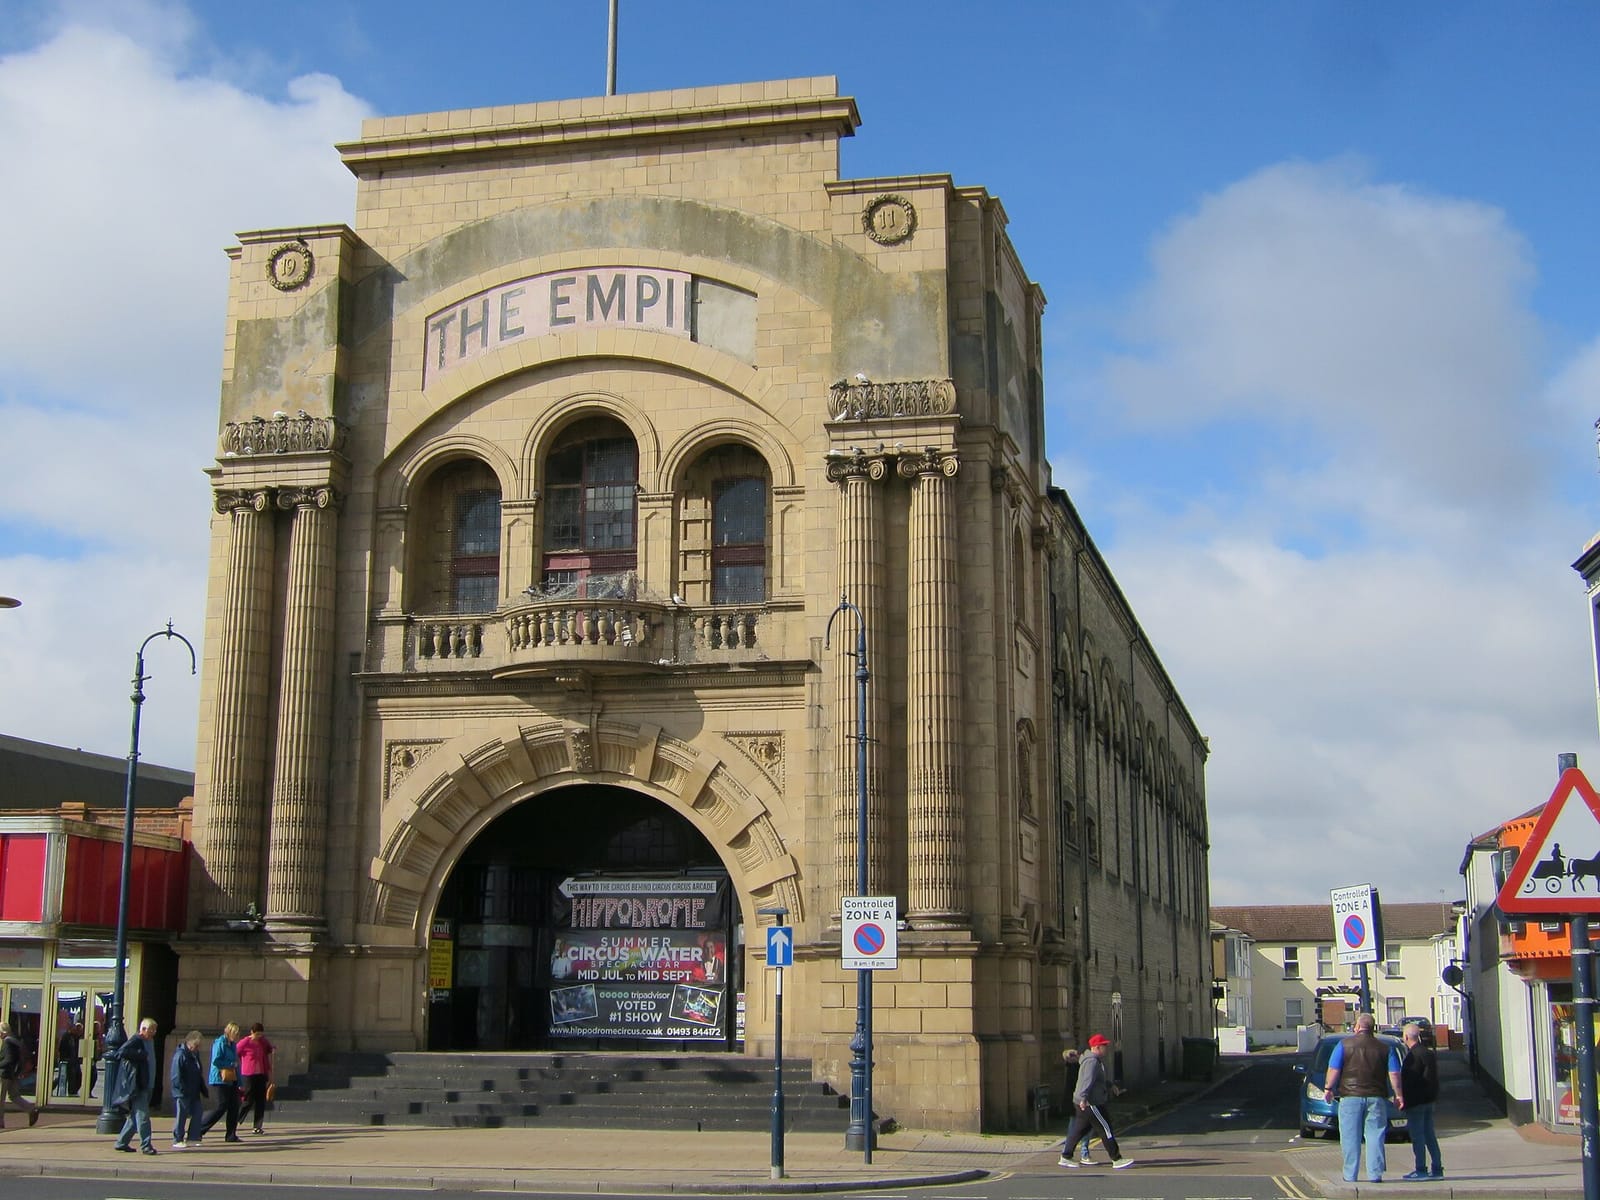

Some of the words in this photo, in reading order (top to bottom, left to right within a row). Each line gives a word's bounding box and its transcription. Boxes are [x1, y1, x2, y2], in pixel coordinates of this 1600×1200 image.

[281, 258, 297, 277] 19
[431, 288, 527, 371] THE
[567, 883, 578, 891] THIS
[579, 883, 591, 891] WAY
[592, 883, 599, 891] TO
[600, 883, 610, 891] THE
[611, 883, 630, 891] CIRCUS
[631, 883, 651, 891] BEHIND
[652, 883, 671, 891] CIRCUS
[672, 883, 691, 891] CIRCUS
[692, 883, 715, 891] ARCADE
[1333, 888, 1369, 901] Controlled
[844, 900, 894, 908] Controlled
[1336, 901, 1359, 913] ZONE
[1362, 900, 1368, 909] A
[571, 898, 706, 928] HIPPODROME
[846, 911, 879, 920] ZONE
[884, 911, 892, 919] A
[601, 937, 671, 948] SUMMER
[567, 947, 630, 961] CIRCUS
[640, 947, 703, 961] WATER
[591, 960, 680, 968] SPECTACULAR
[578, 970, 599, 980] MID
[601, 970, 623, 980] JUL
[638, 970, 659, 980] MID
[662, 970, 692, 981] SEPT
[631, 991, 671, 1000] tripadvisor
[616, 1000, 656, 1011] VOTED
[609, 1012, 622, 1022] #1
[625, 1012, 662, 1023] SHOW
[550, 1026, 663, 1037] www.hippodromecircus.co.uk
[666, 1027, 691, 1036] 01493
[693, 1027, 721, 1036] 844172
